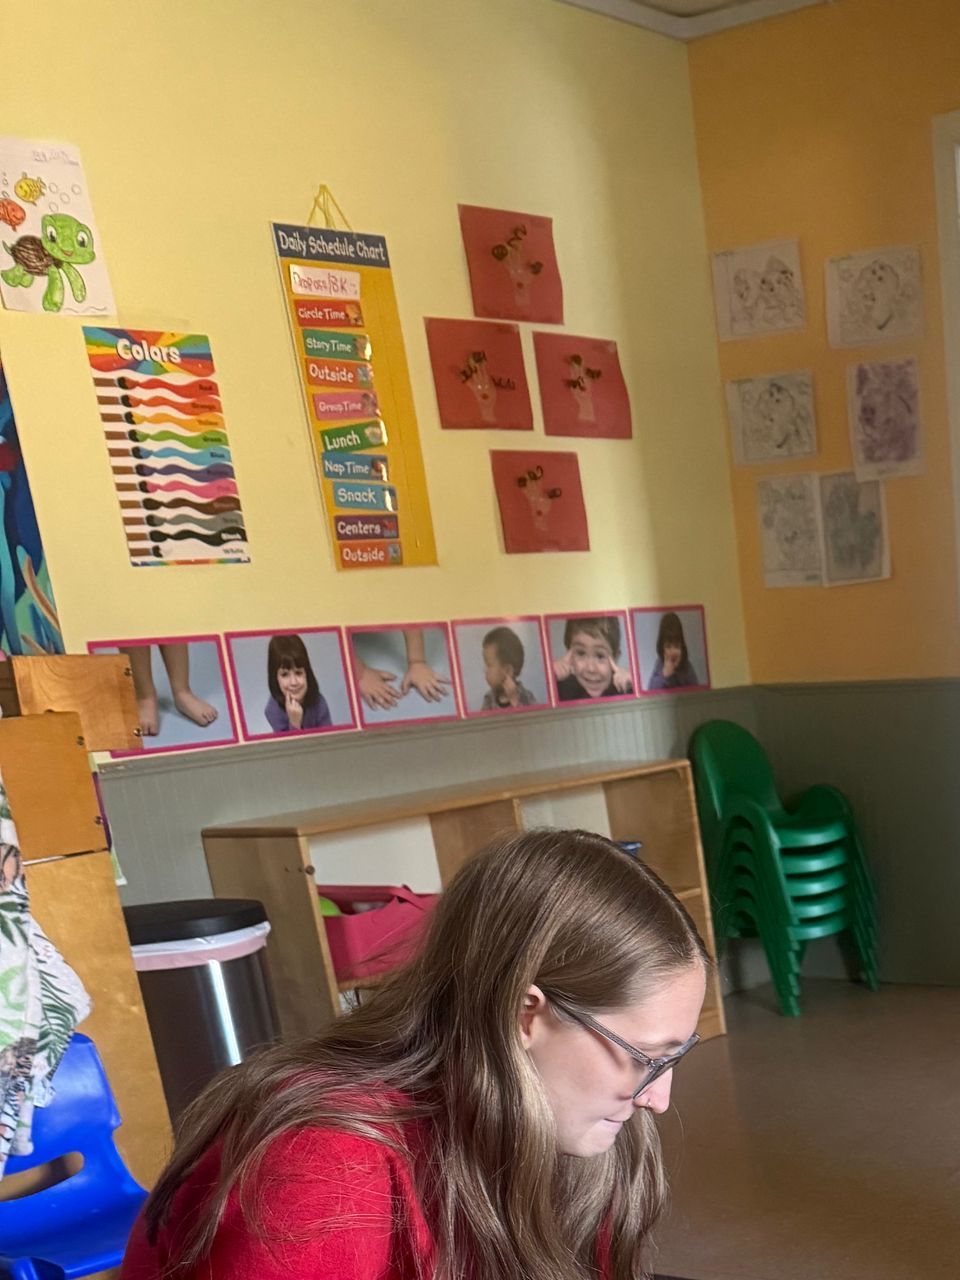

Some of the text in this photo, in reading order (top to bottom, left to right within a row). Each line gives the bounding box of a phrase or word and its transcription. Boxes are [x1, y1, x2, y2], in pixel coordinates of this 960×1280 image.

[278, 231, 386, 261] Daily Schedule Chart
[298, 308, 346, 320] Circle Time
[116, 337, 182, 364] Colors
[306, 337, 352, 352] Story Time
[309, 363, 354, 383] Outside
[318, 401, 362, 412] Group Time
[324, 430, 361, 450] Lunch
[324, 460, 370, 476] Nap Time
[337, 488, 377, 504] Snack
[337, 521, 381, 535] Centers
[342, 547, 385, 562] Outside
